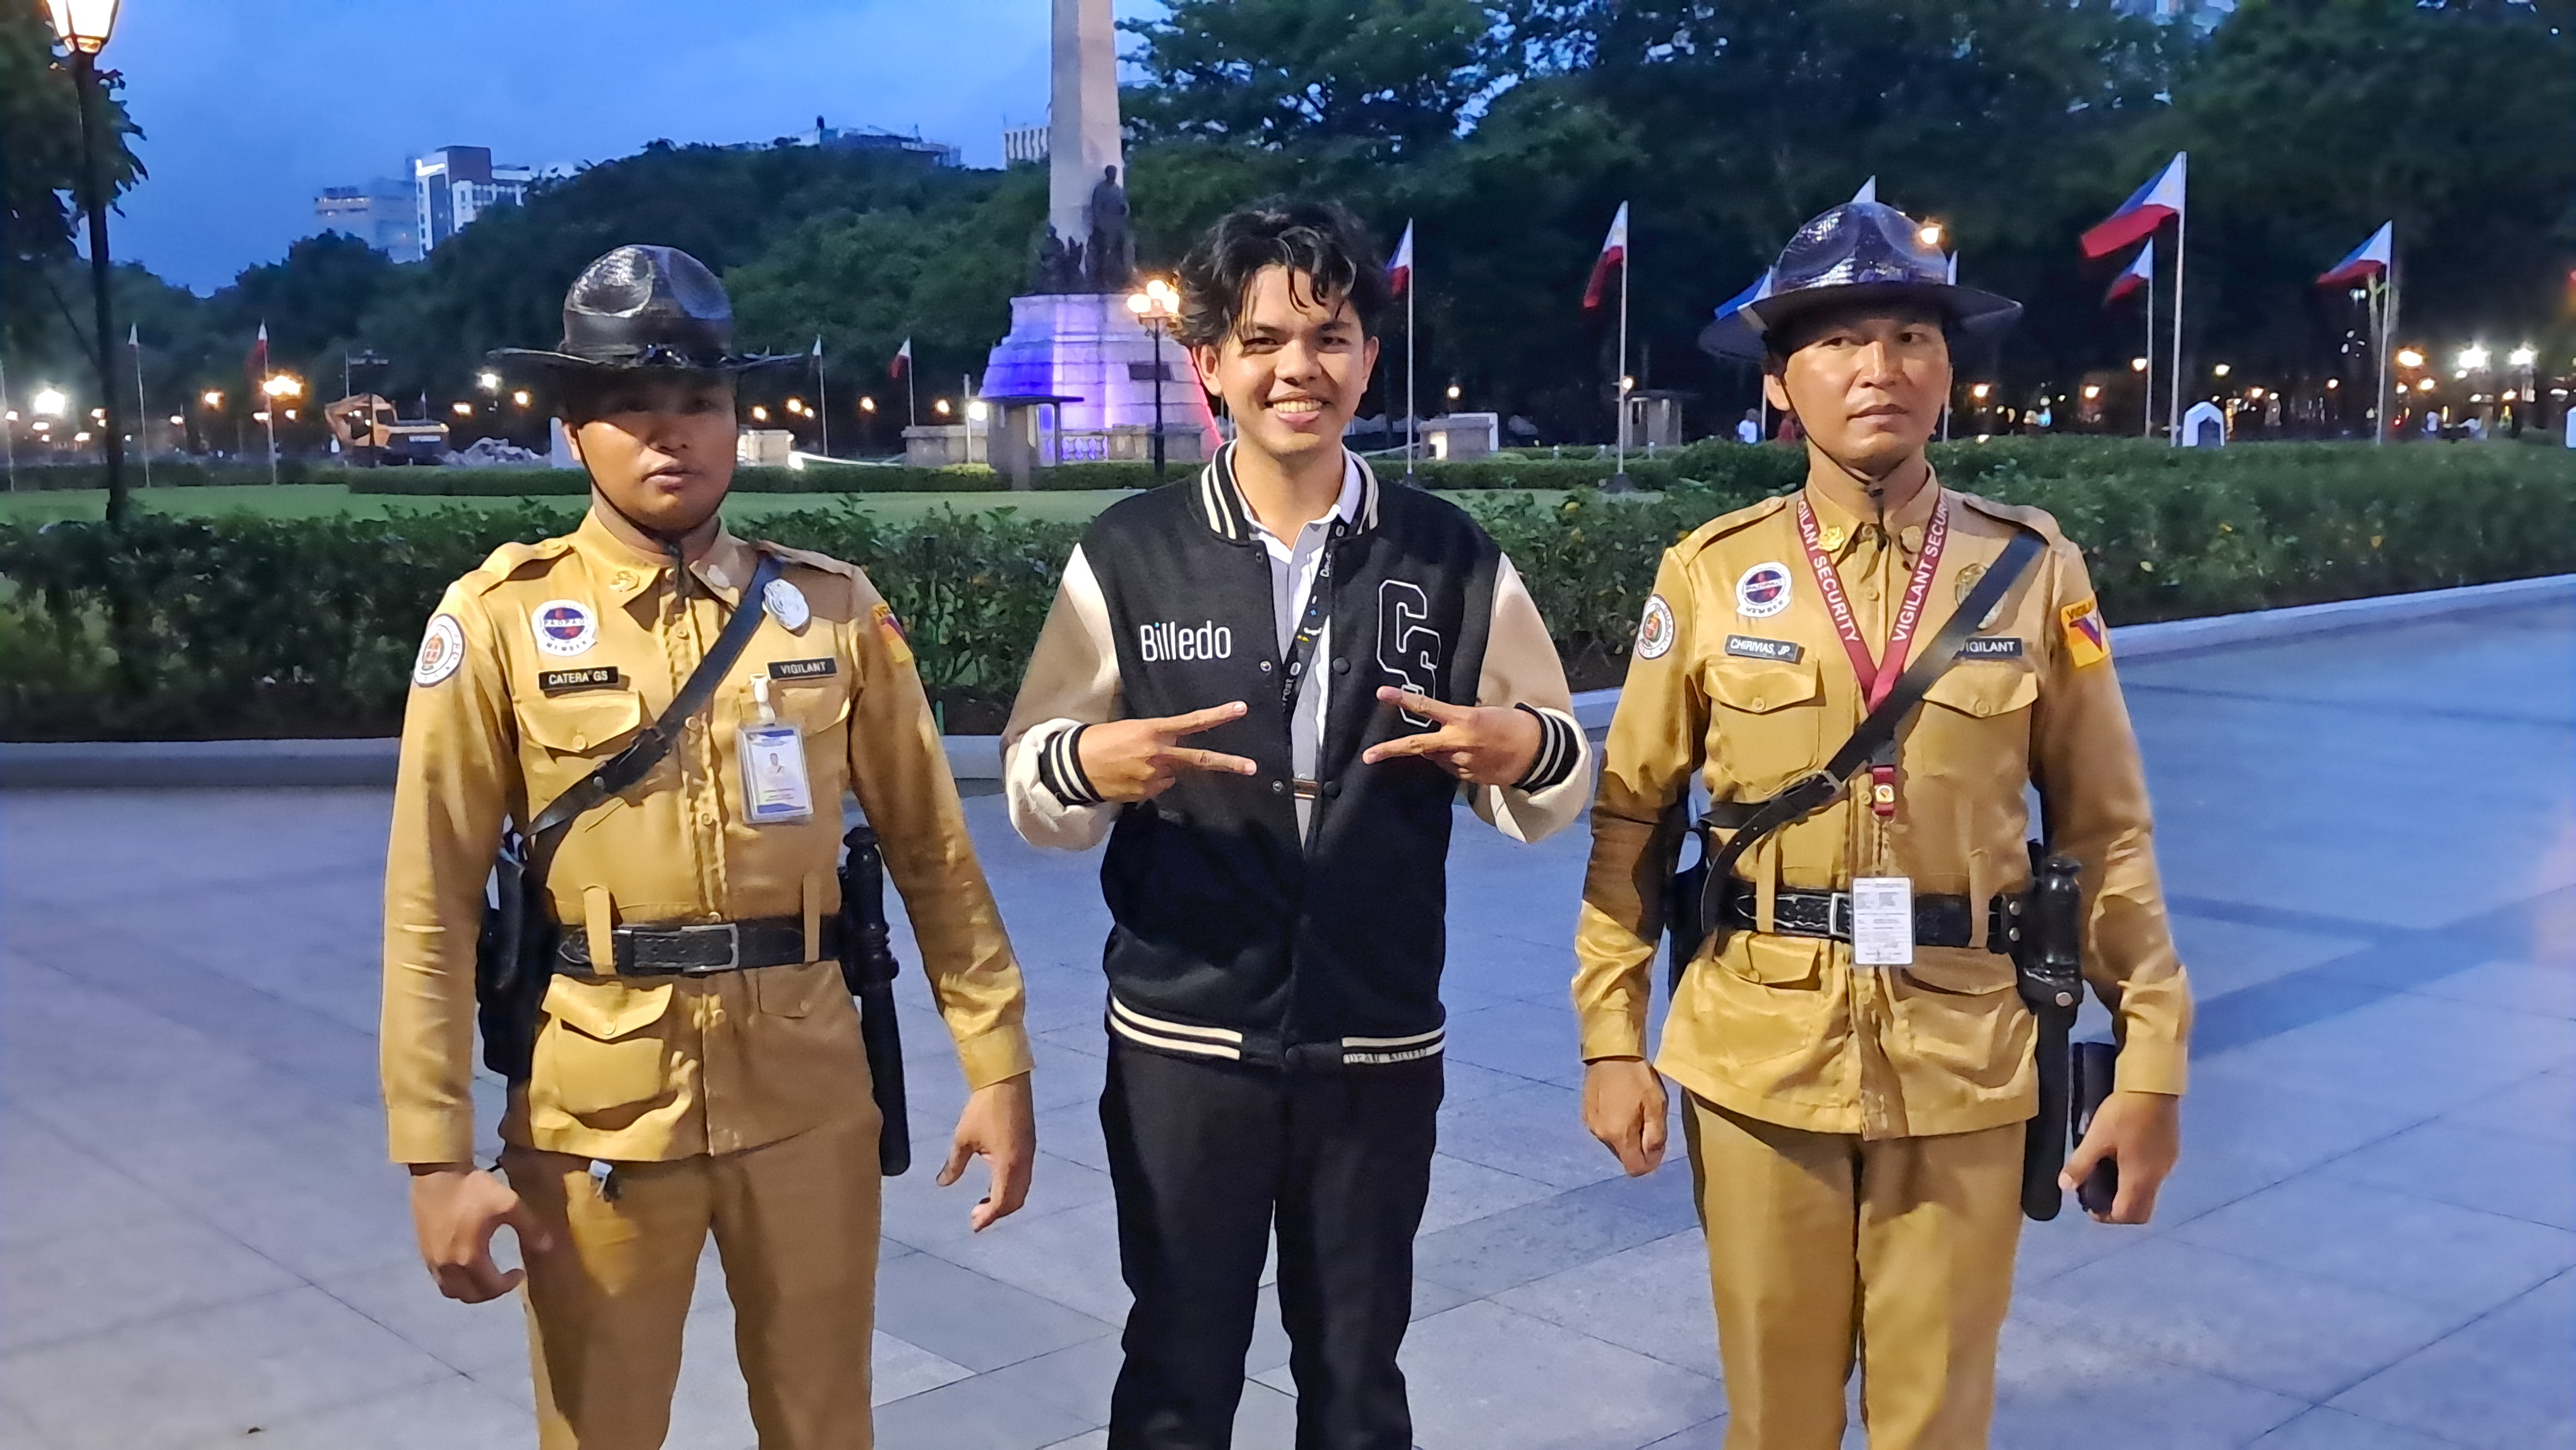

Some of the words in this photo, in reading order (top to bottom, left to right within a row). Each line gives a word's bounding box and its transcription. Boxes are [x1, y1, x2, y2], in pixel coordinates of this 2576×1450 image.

[1798, 500, 1820, 551] GILANT
[1813, 555, 1860, 642] SECURITY
[1892, 558, 1933, 641] VIGILANT
[1140, 620, 1231, 661] Billedo
[1960, 640, 2015, 652] IGILANT
[548, 672, 590, 685] CATERA
[593, 670, 609, 681] GS
[780, 661, 826, 674] VIGILANT
